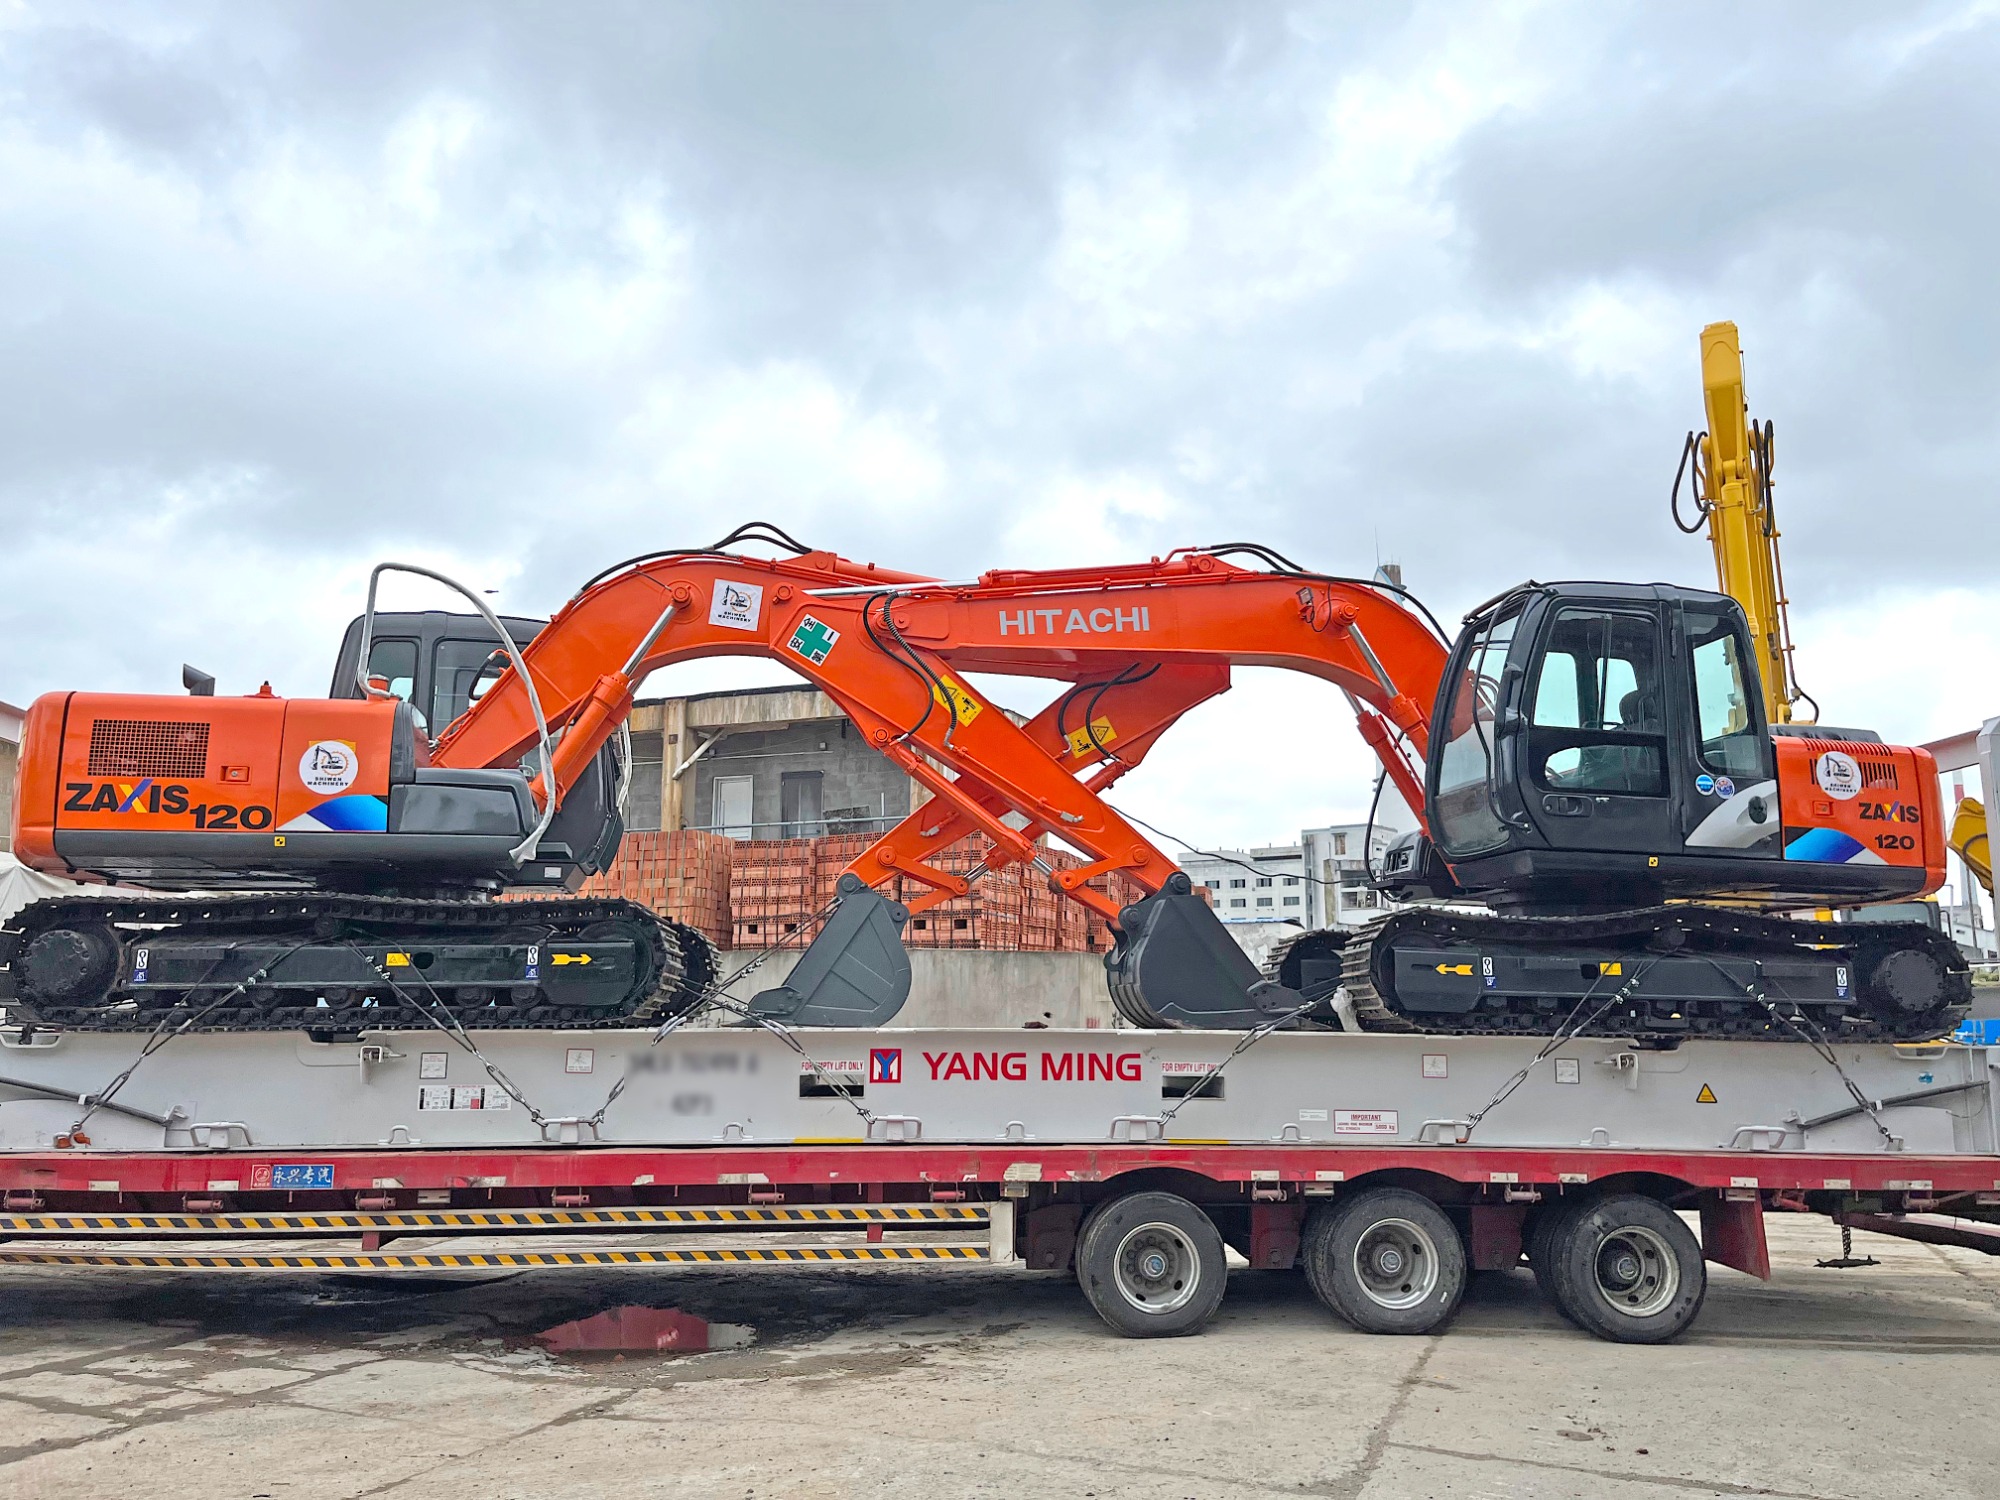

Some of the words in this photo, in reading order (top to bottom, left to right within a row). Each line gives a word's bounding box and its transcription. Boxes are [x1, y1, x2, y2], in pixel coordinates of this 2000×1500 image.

[717, 614, 752, 623] MACHINERY
[999, 607, 1150, 635] HITACHI
[64, 779, 190, 815] ZAXIS
[190, 804, 273, 830] 120
[1859, 800, 1920, 823] ZAXIS
[1875, 834, 1915, 850] 120
[835, 1061, 847, 1071] LIFT
[849, 1061, 864, 1071] ONLY
[922, 1052, 1027, 1080] YANG
[1042, 1053, 1142, 1081] MING
[1162, 1063, 1173, 1072] FOR
[1174, 1063, 1193, 1072] EMPTY
[1194, 1063, 1206, 1072] LIFT
